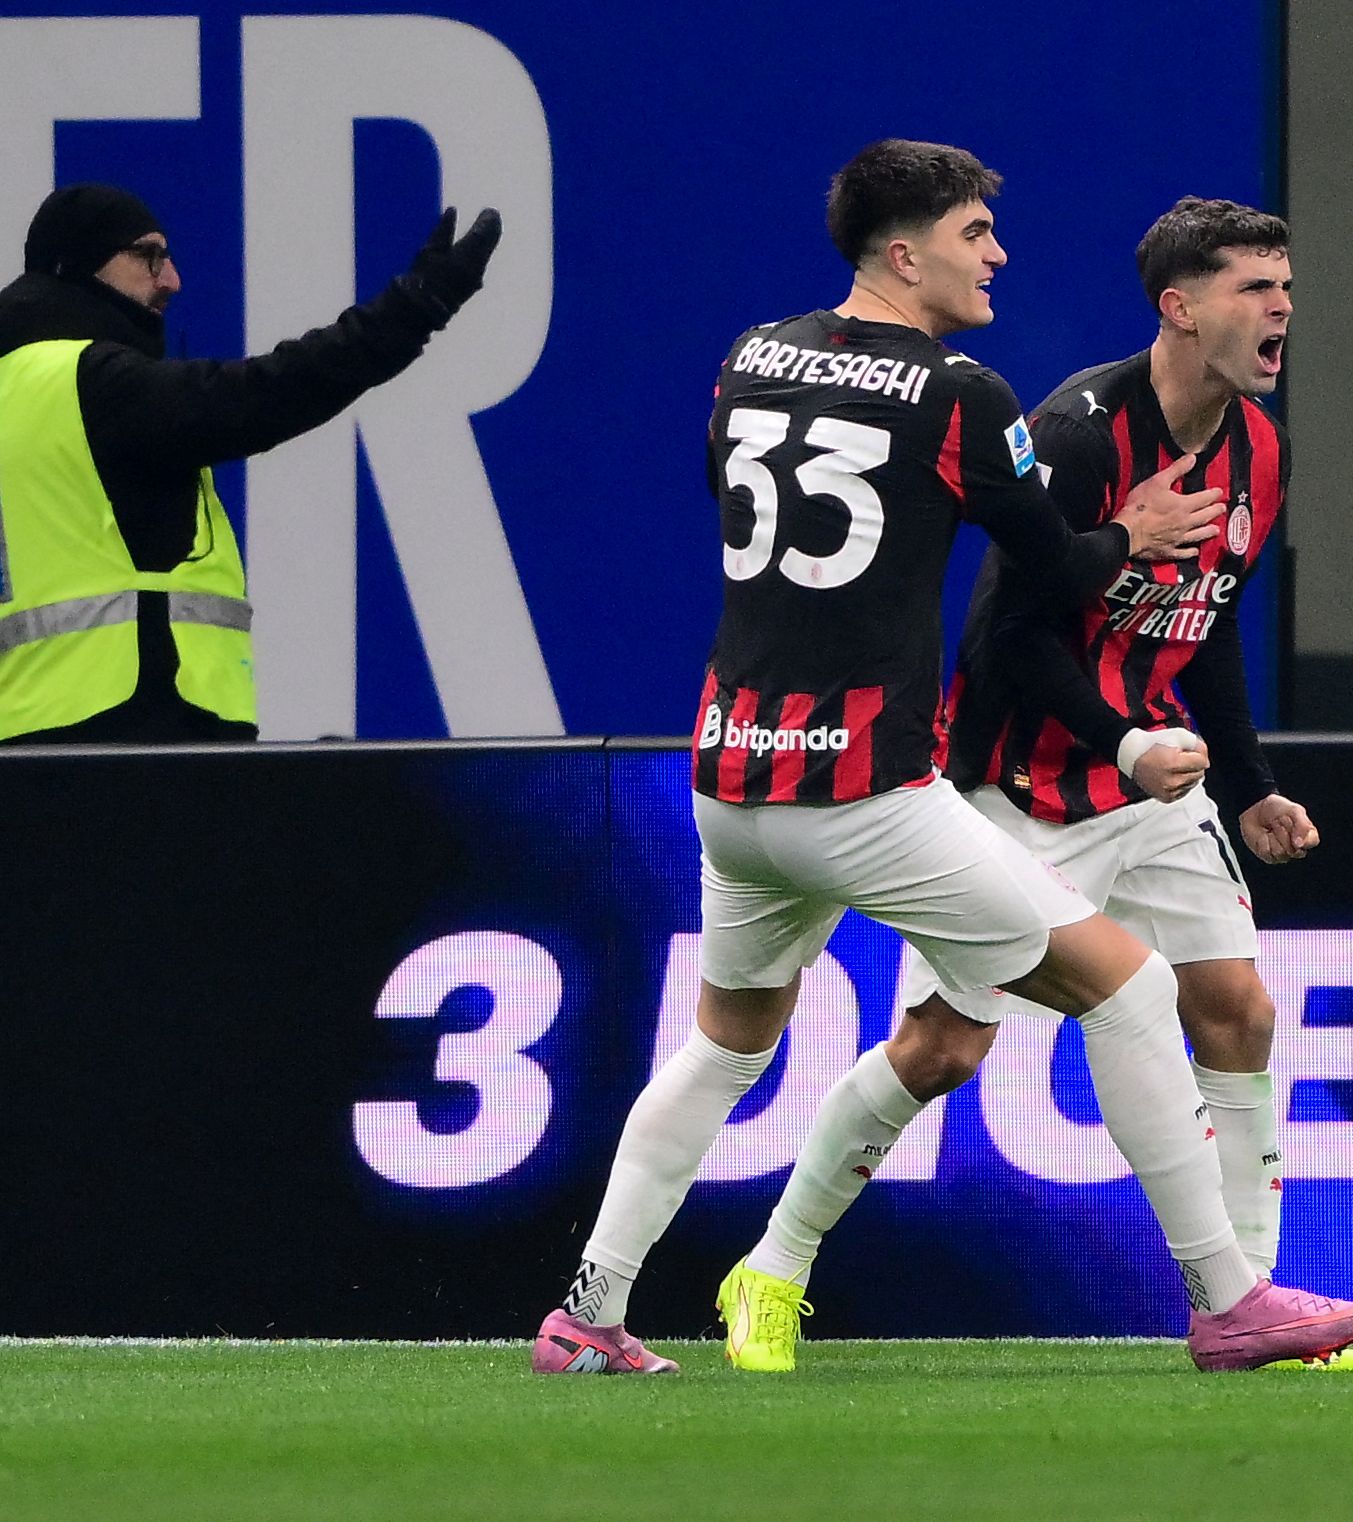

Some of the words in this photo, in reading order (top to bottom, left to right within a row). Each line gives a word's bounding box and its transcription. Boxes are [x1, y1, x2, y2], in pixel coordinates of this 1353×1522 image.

[732, 336, 932, 404] BARTESAGHI
[723, 407, 891, 589] 33
[1136, 607, 1218, 641] BETTER
[724, 718, 849, 758] bitpanda
[352, 930, 563, 1188] 3
